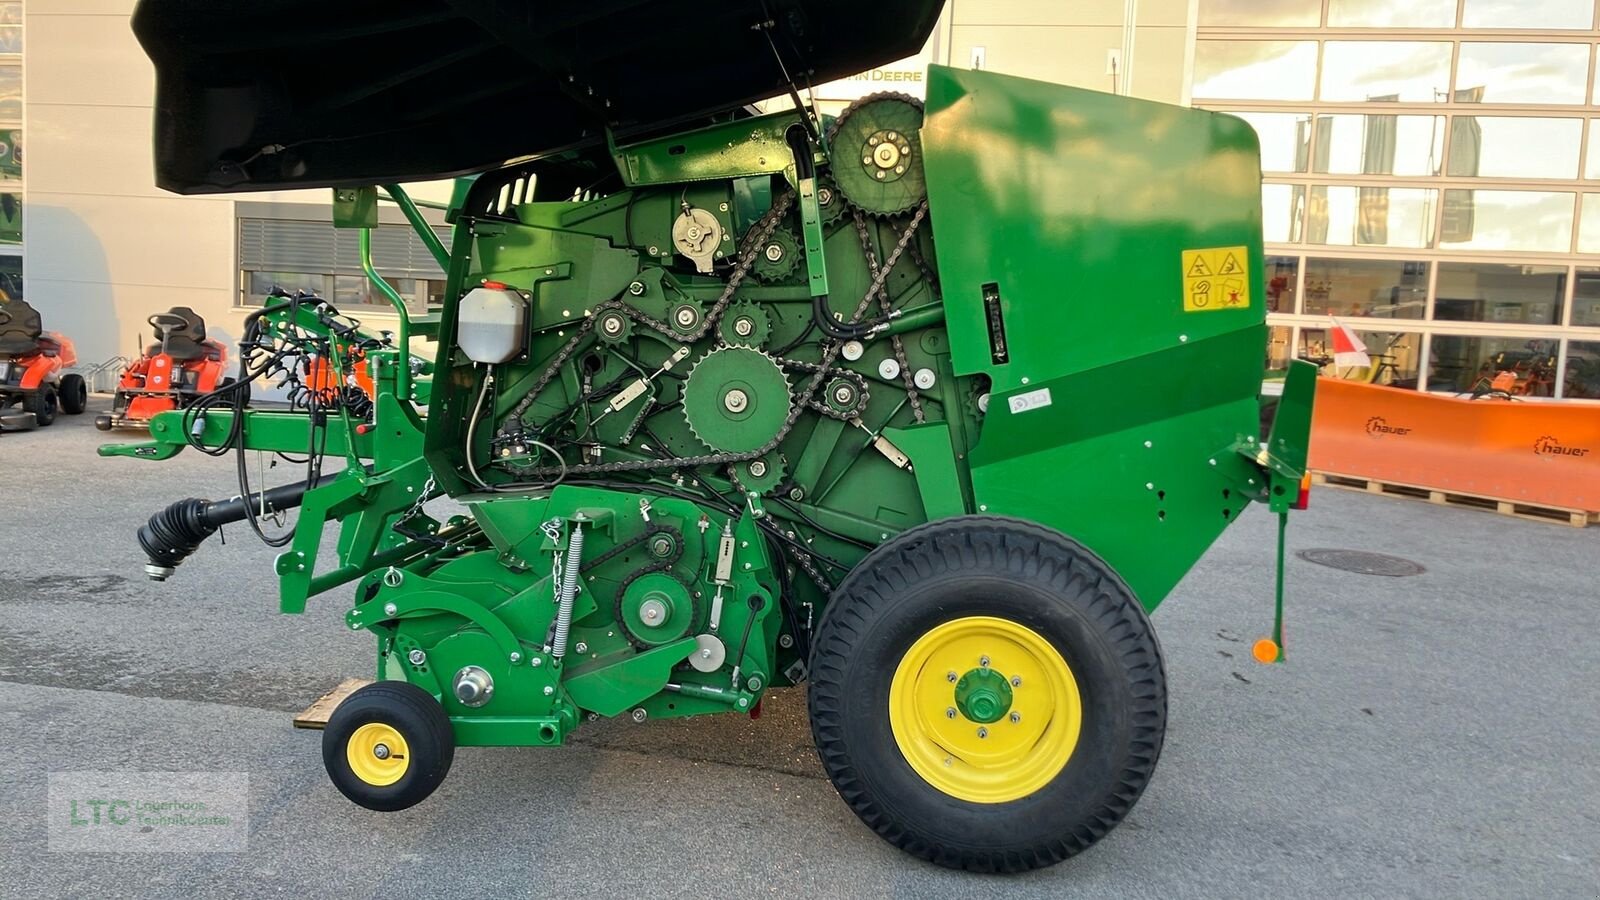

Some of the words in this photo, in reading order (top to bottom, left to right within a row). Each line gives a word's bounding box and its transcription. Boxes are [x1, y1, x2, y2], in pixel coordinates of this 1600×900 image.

[872, 70, 922, 81] DEERE
[1373, 421, 1412, 436] hauer
[1542, 442, 1590, 457] hauer
